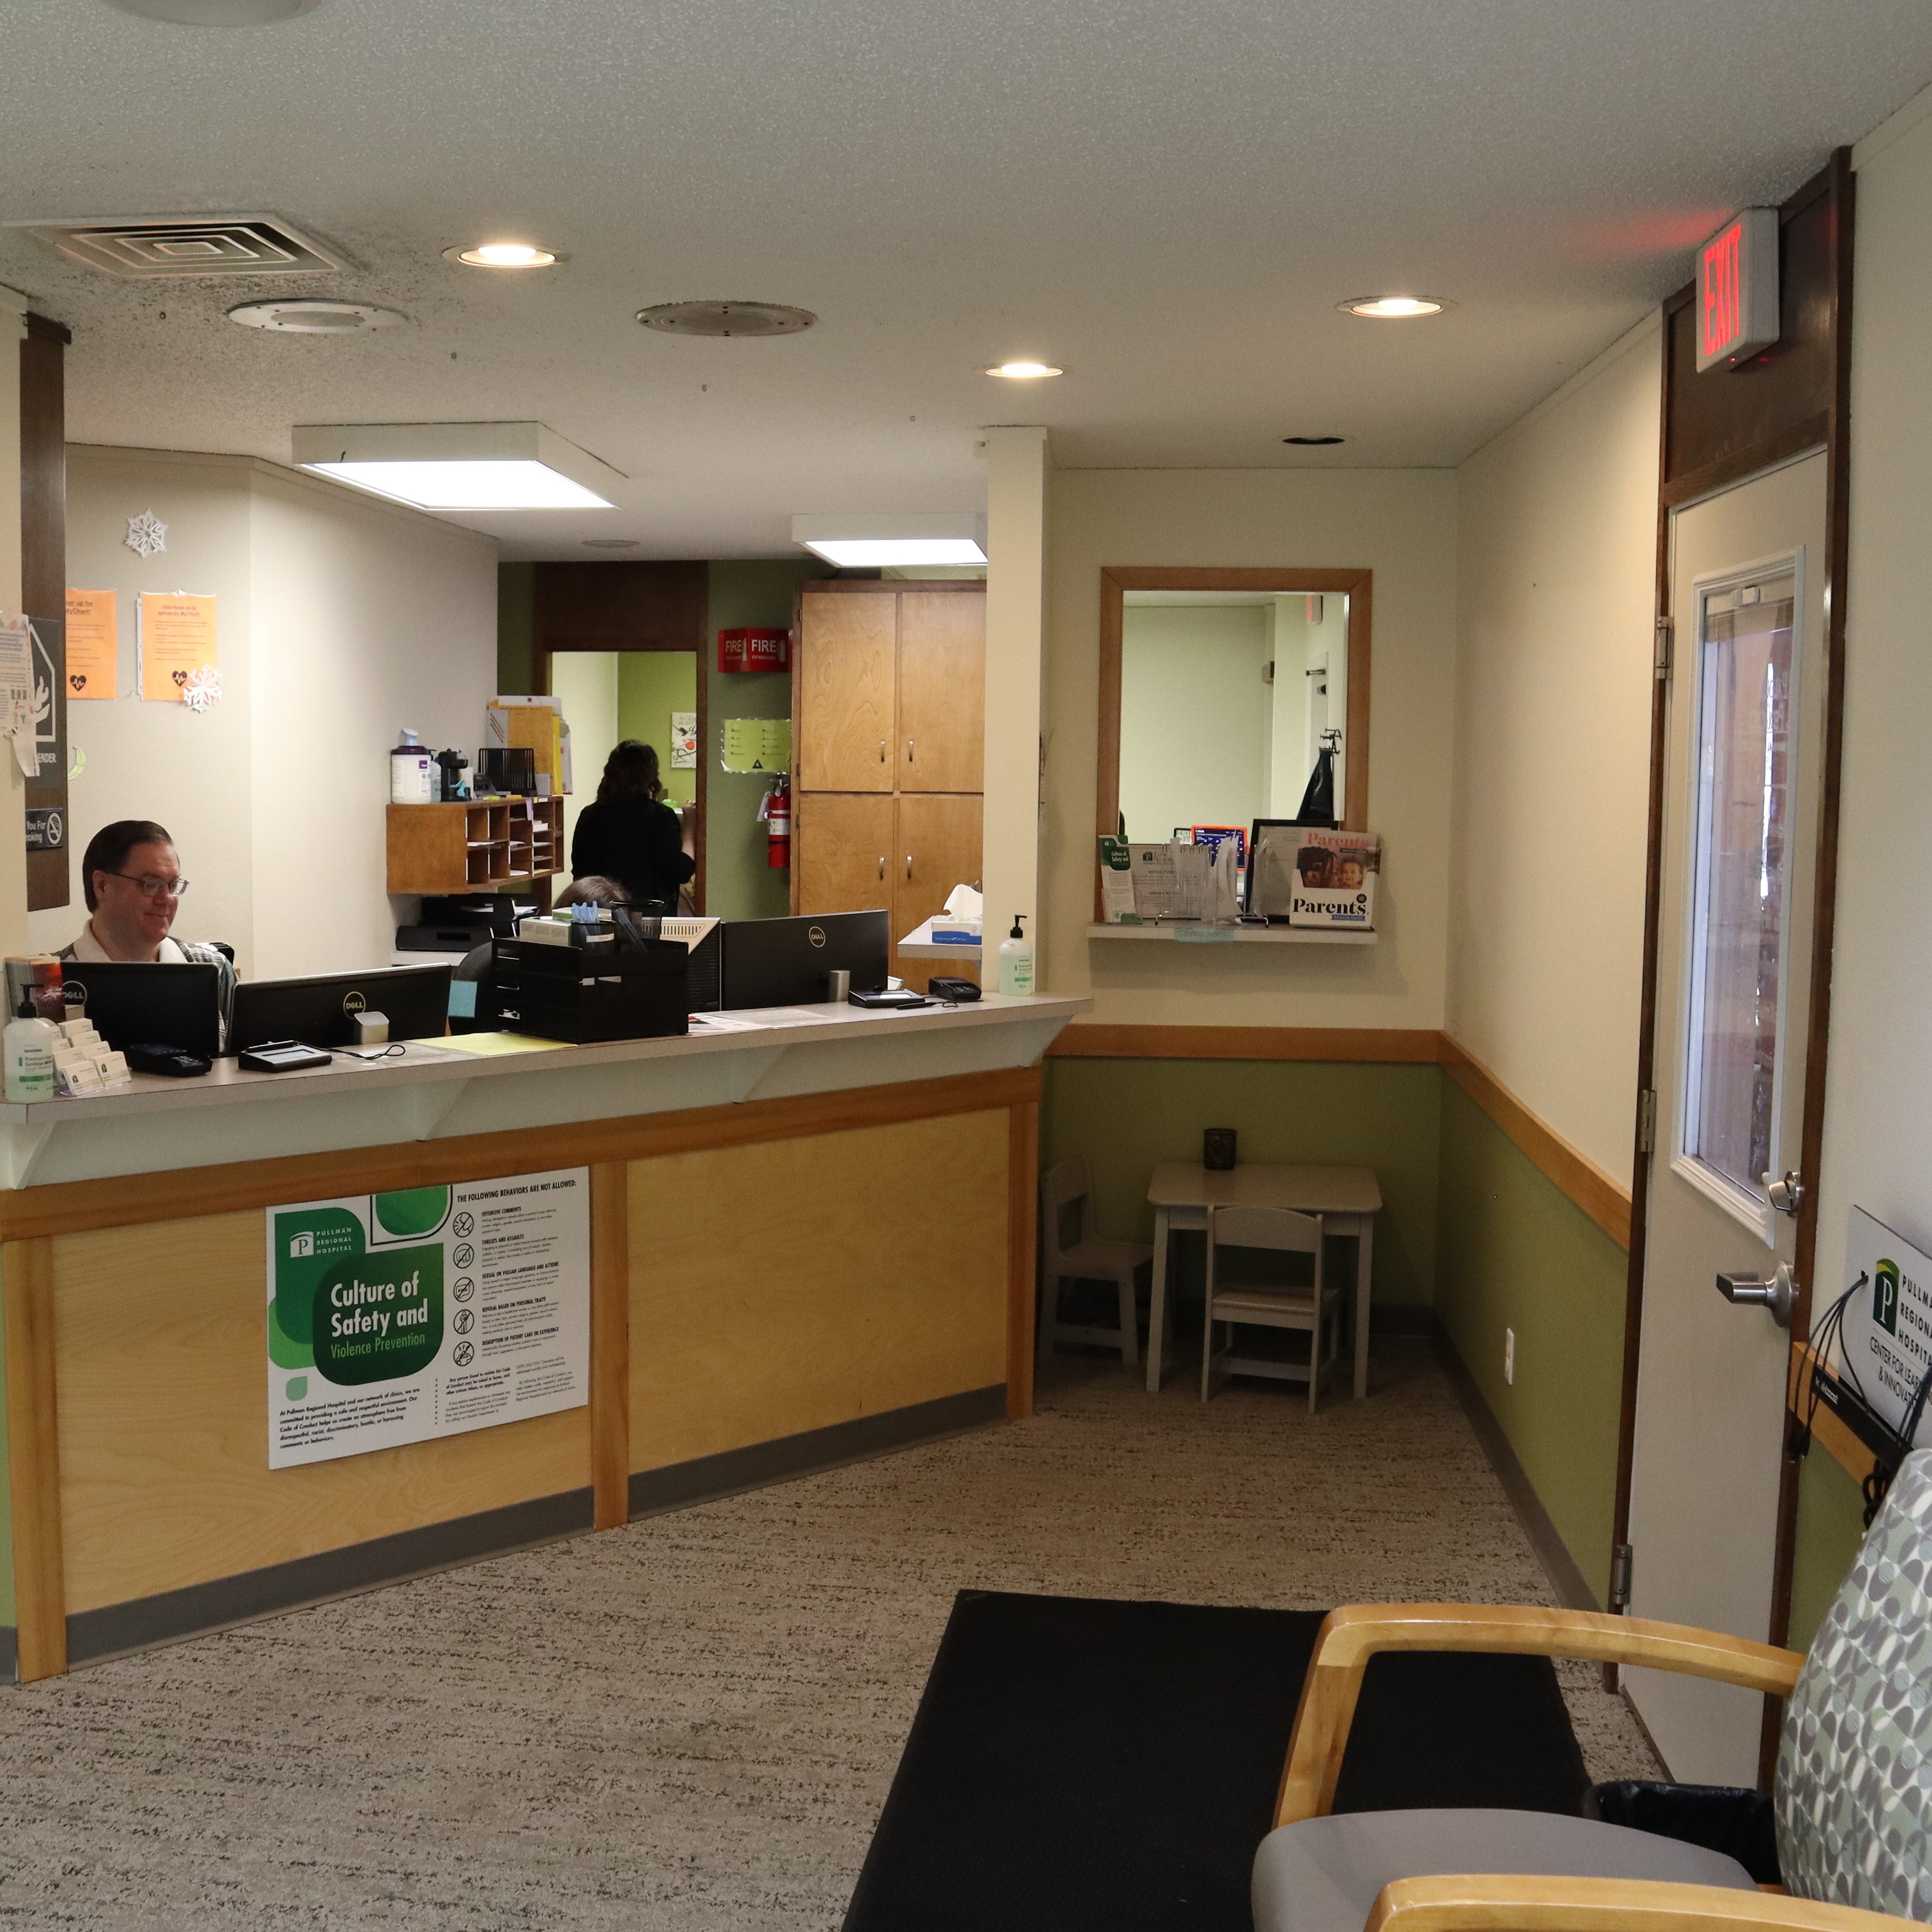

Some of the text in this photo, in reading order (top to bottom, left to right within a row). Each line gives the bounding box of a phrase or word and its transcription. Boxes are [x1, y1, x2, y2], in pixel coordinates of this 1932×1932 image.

[1704, 224, 1742, 357] EXIT
[726, 640, 742, 652] FIRE
[751, 639, 777, 652] FIRE
[37, 753, 56, 763] ENDER
[26, 820, 46, 830] You For
[26, 832, 42, 843] oking
[1308, 832, 1369, 848] Parents
[1294, 899, 1366, 914] Parents
[346, 1002, 363, 1010] DELL
[468, 1190, 498, 1201] FOLLOWING
[500, 1186, 528, 1197] BEHAVIORS
[540, 1183, 551, 1191] NOT
[552, 1180, 577, 1189] ALLOWED:
[317, 1227, 352, 1237] PULLMAN
[298, 1239, 308, 1255] P
[317, 1237, 352, 1245] REGIONAL
[317, 1245, 352, 1255] HOSPITAL
[330, 1270, 419, 1307] Culture of
[1902, 1275, 1932, 1309] PULLMA
[1880, 1276, 1893, 1325] P
[331, 1298, 428, 1337] Safety and
[1900, 1302, 1932, 1339] REGIONA
[539, 1326, 559, 1335] EXPERIENCE
[331, 1333, 425, 1359] Violence Prevention
[1899, 1329, 1932, 1366] HOSPITA
[1870, 1335, 1891, 1366] CENTER
[1892, 1355, 1904, 1378] FOR
[1879, 1366, 1883, 1381] &
